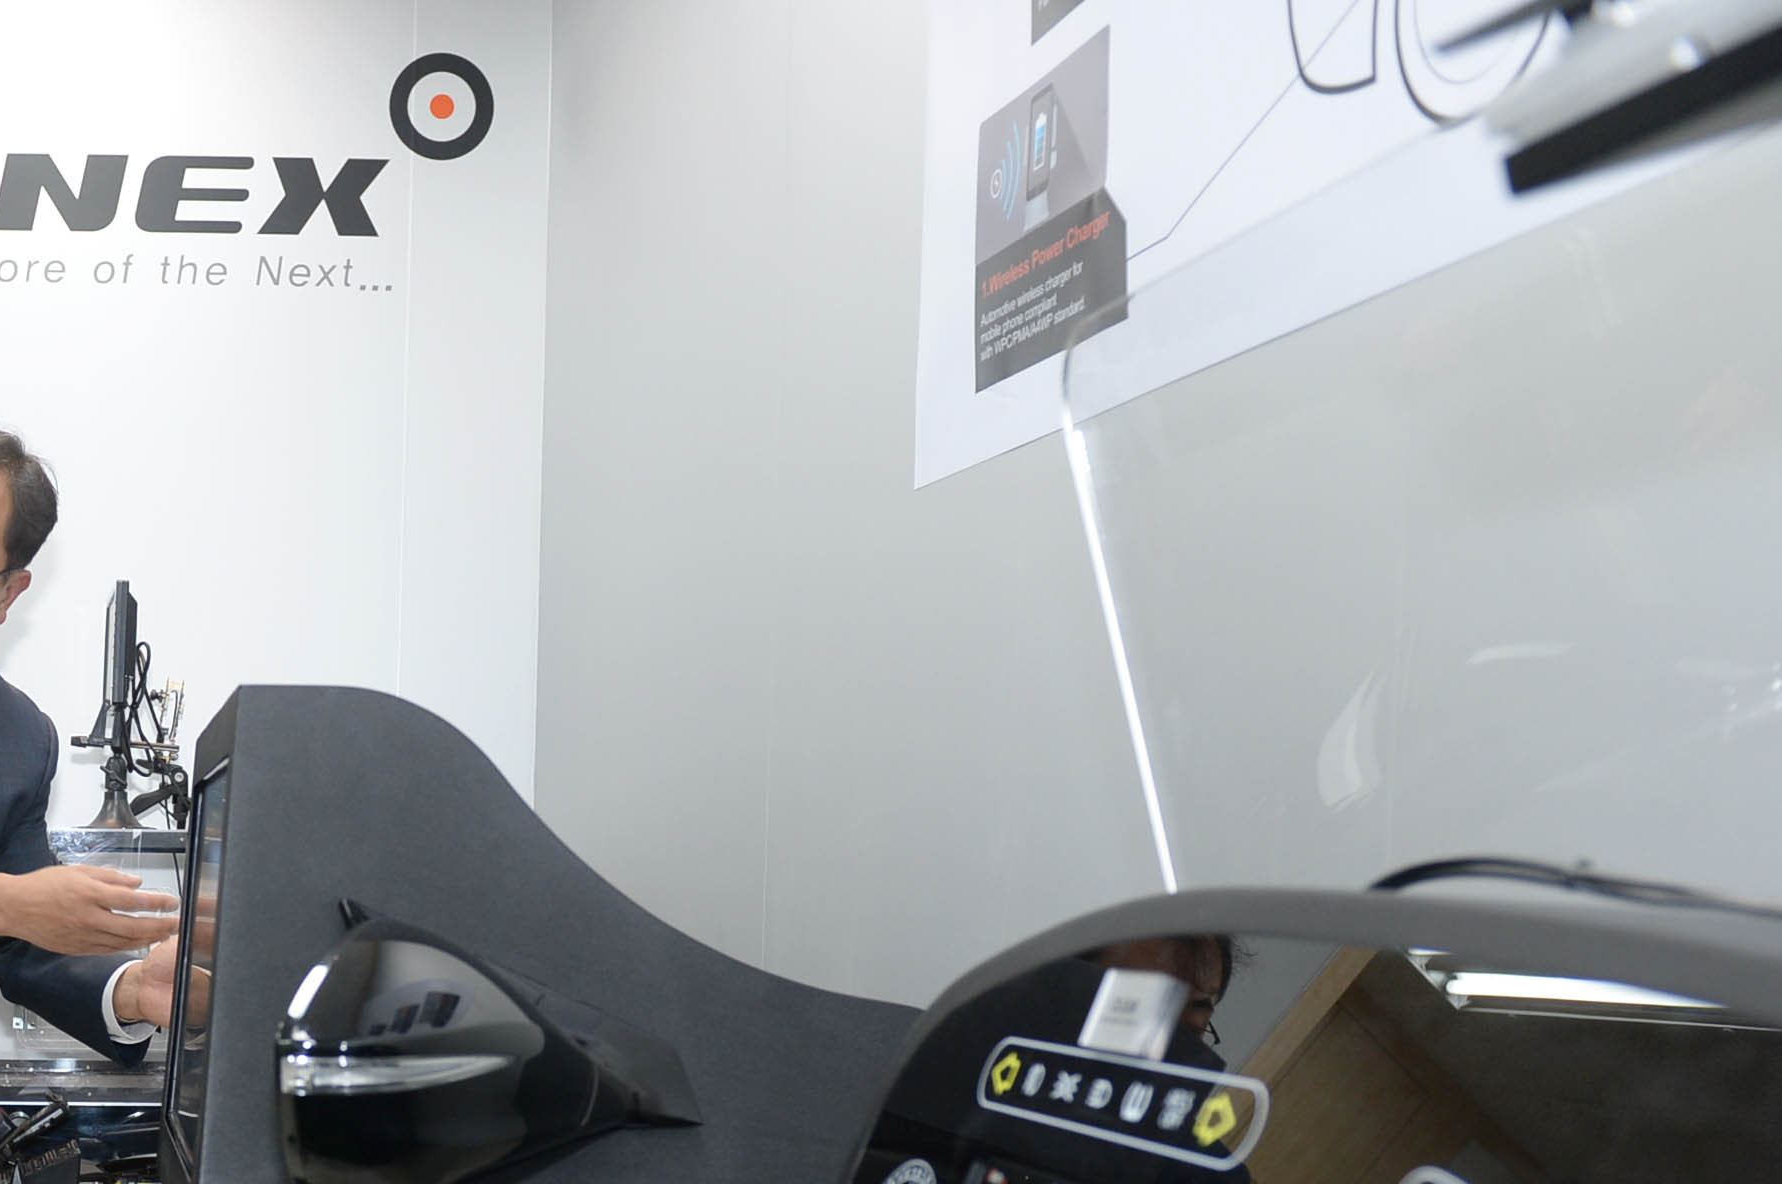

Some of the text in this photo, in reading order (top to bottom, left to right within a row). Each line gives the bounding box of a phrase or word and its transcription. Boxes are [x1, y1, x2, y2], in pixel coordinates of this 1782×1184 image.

[1031, 237, 1066, 269] Power
[1067, 210, 1111, 250] Charger
[93, 253, 134, 285] of
[160, 254, 228, 286] the
[255, 255, 393, 292] Next...
[980, 259, 1085, 328] Automotive wireless charger for
[980, 293, 1058, 345] mobile phone compliant
[980, 345, 995, 362] with
